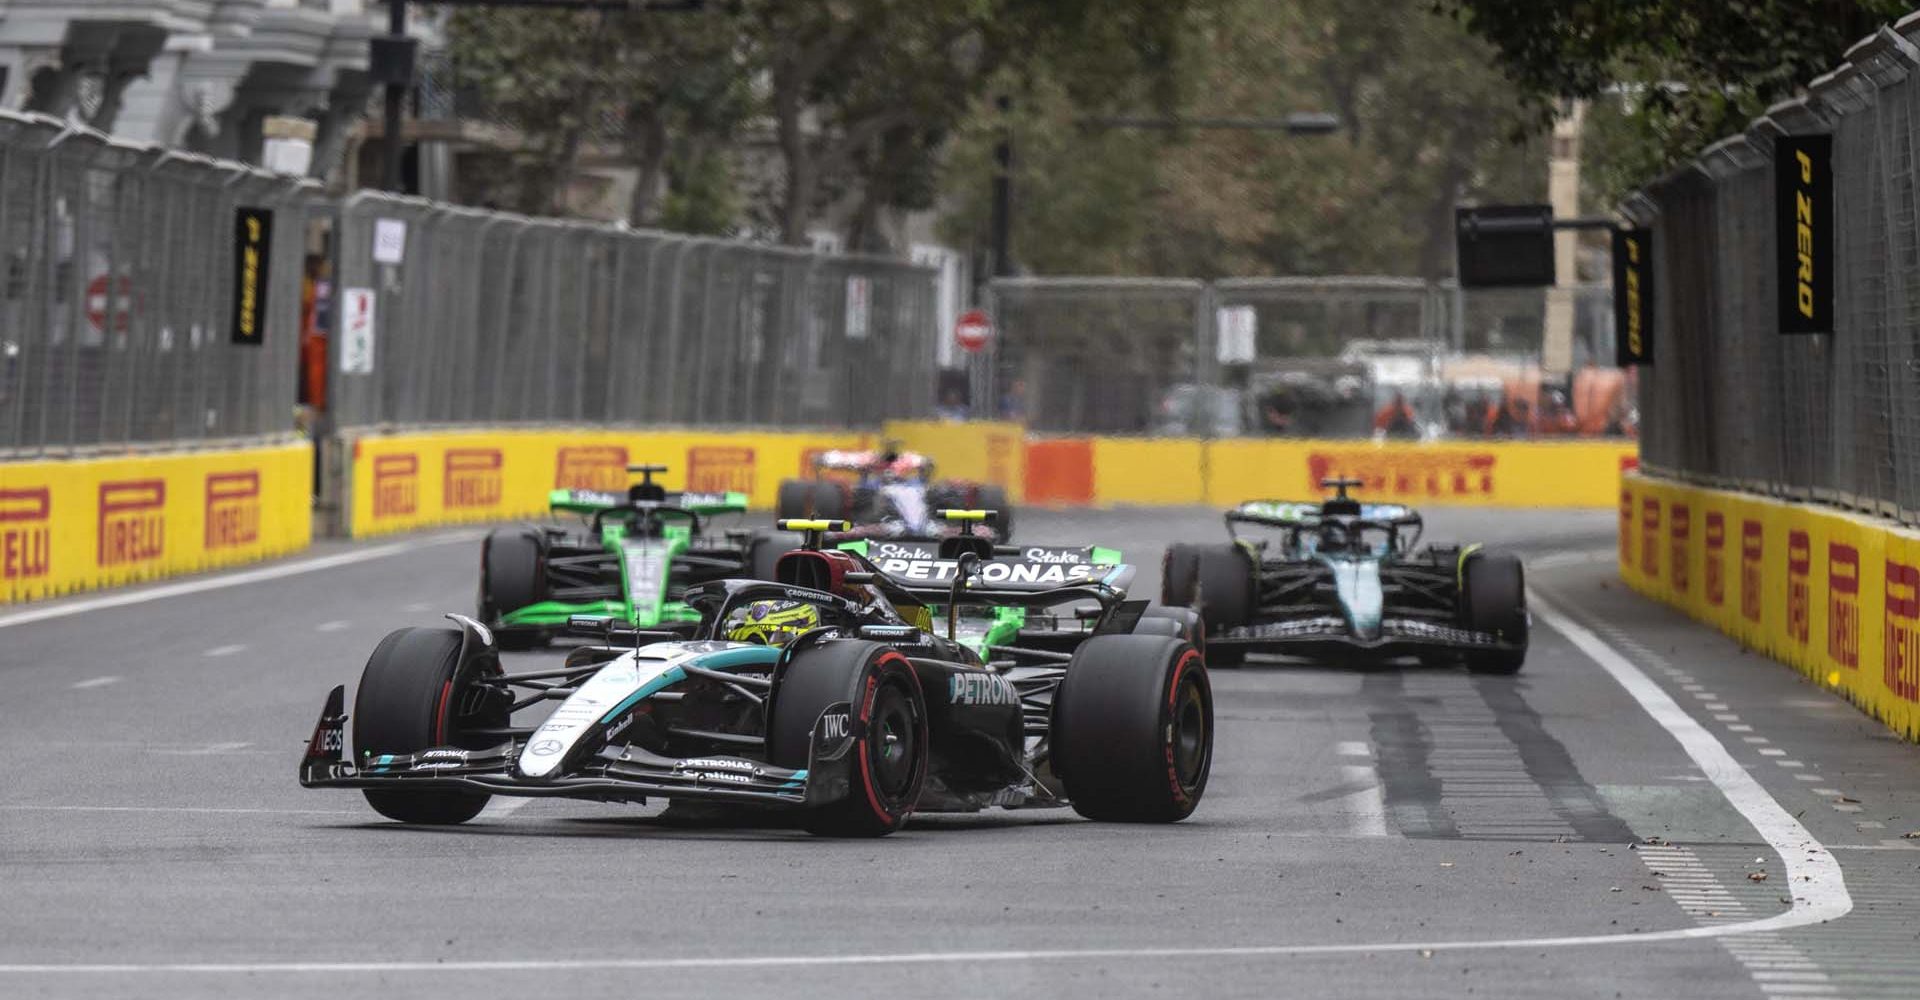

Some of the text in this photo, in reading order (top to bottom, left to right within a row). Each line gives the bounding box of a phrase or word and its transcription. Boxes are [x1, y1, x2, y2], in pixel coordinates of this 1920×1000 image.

[1796, 150, 1813, 319] P ZERO
[98, 478, 165, 567] PIRELLI
[881, 559, 1093, 583] PETONAS
[788, 589, 833, 602] CROWDSTRIKE
[824, 714, 849, 739] IWC
[687, 758, 753, 770] PETRONAS
